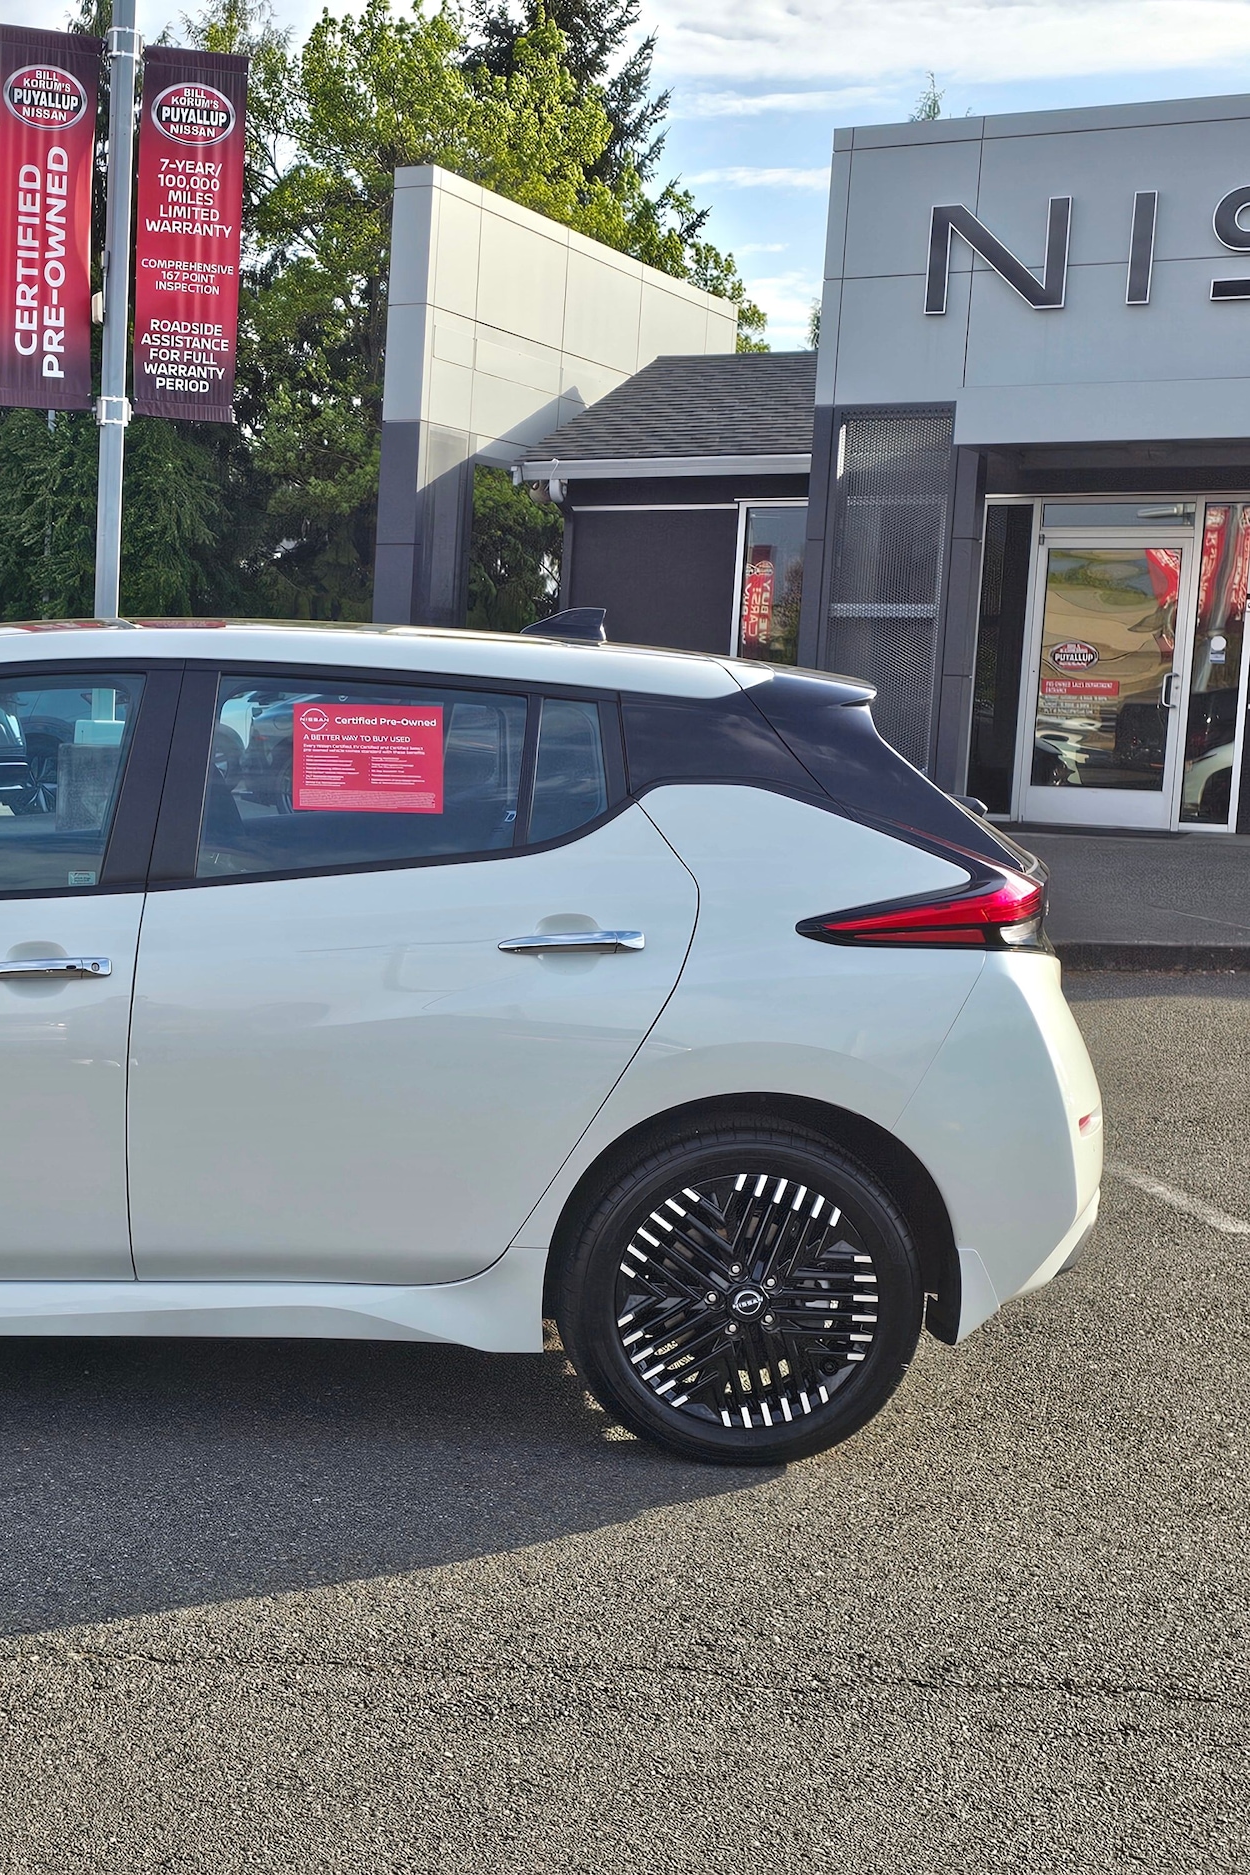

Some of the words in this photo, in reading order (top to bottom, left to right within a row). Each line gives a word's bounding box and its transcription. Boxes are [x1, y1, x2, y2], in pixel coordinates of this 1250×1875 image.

[35, 70, 59, 81] BILL
[23, 77, 71, 93] KORUM'S
[183, 88, 207, 99] BILL
[13, 87, 79, 111] PUYALLUP
[171, 96, 219, 109] KORUM'S
[22, 106, 67, 122] NISSAN
[161, 106, 227, 127] PUYALLUP
[170, 124, 216, 138] NISSAN
[159, 158, 223, 178] 7-YEAR/
[157, 174, 220, 191] 100,000
[168, 190, 214, 206] MILES
[159, 204, 220, 222] LIMITED
[145, 218, 232, 238] WARRANTY
[14, 164, 41, 356] CERTIFIED
[42, 146, 69, 378] PRE-OWNED
[141, 258, 234, 275] COMPREHENSIVE
[161, 271, 180, 281] 167
[182, 273, 215, 284] POINT
[155, 281, 220, 295] INSPECTION
[150, 318, 223, 337] ROADSIDE
[141, 333, 229, 351] ASSISTANCE
[149, 348, 180, 362] FOR
[183, 351, 217, 365] FULL
[143, 362, 225, 380] WARRANTY
[156, 377, 210, 393] PERIOD
[334, 716, 377, 725] Certified
[379, 717, 437, 727] Pre-Owned
